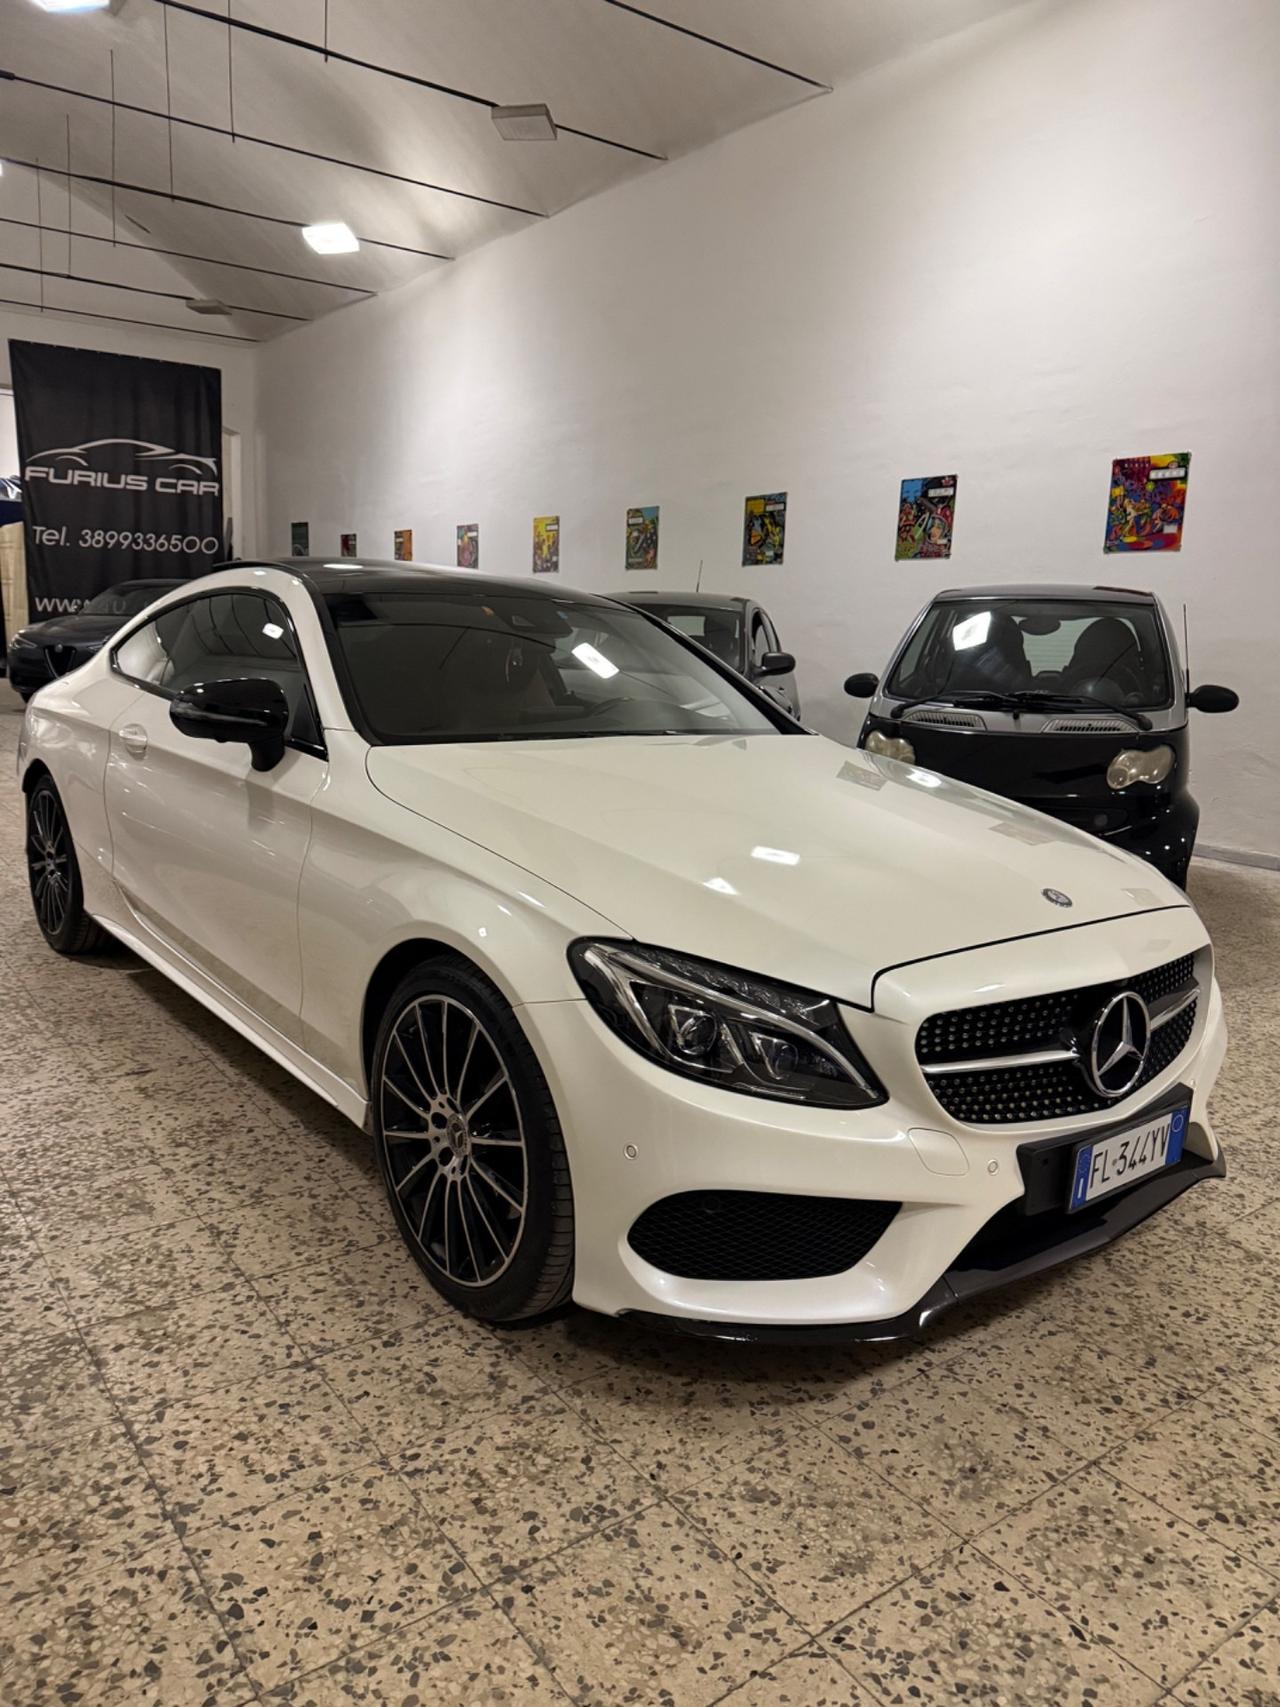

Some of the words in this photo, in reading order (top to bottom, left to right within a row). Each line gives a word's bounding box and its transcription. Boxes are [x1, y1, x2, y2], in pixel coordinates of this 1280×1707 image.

[24, 466, 148, 491] FURIUS
[155, 477, 219, 497] CAR
[32, 526, 70, 547] Tel.
[78, 529, 219, 554] 3899336500
